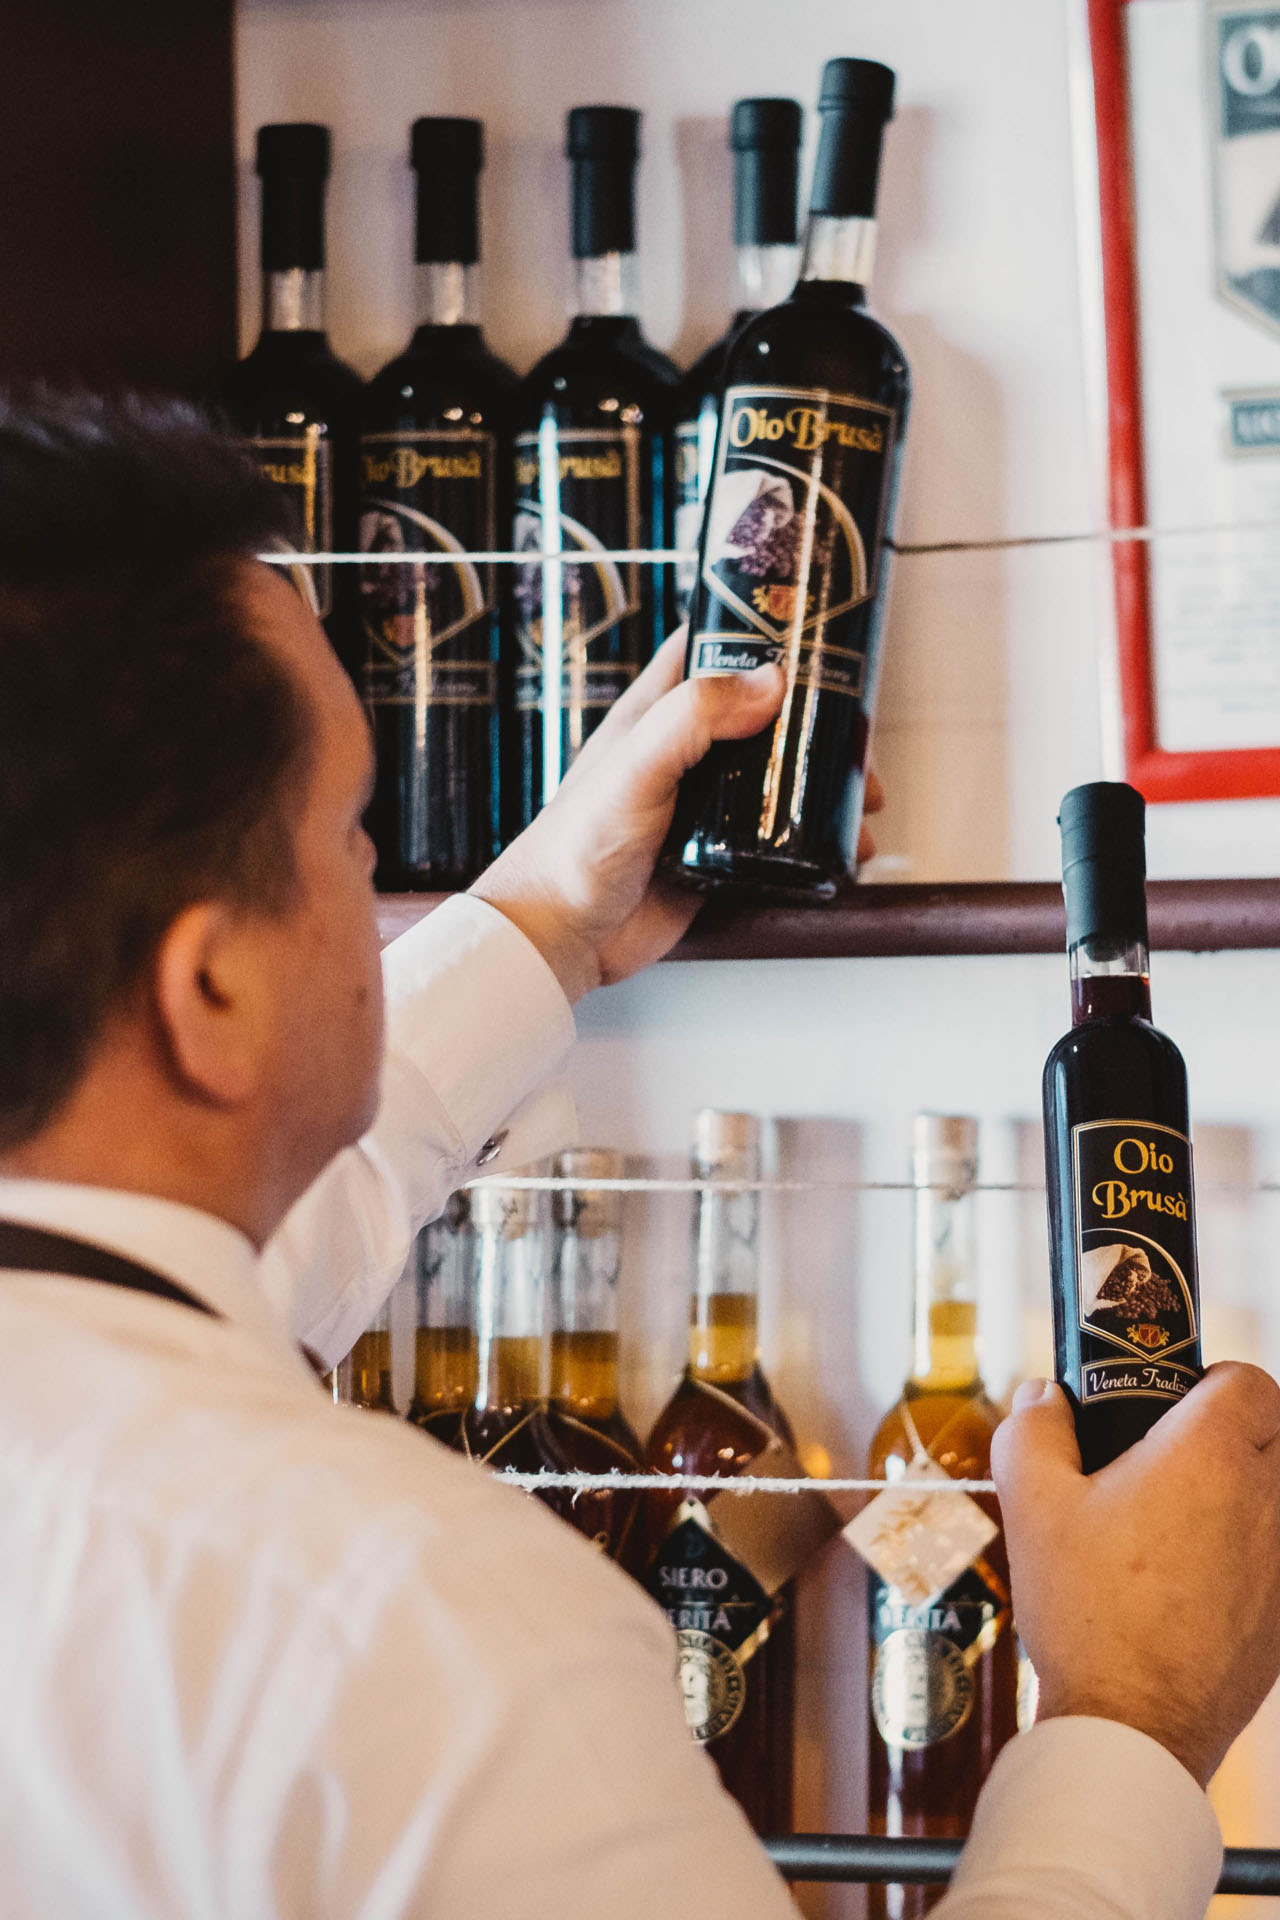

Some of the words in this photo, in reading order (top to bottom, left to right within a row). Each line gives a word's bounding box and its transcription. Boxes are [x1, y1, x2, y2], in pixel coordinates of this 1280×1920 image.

[728, 406, 785, 447] Oio
[785, 407, 883, 453] Brusà
[702, 643, 759, 668] Veneta
[1113, 1138, 1174, 1175] Oio
[1092, 1179, 1188, 1222] Brusà
[1089, 1370, 1138, 1392] Veneta
[657, 1565, 729, 1591] SIERO
[667, 1608, 733, 1632] ERITA
